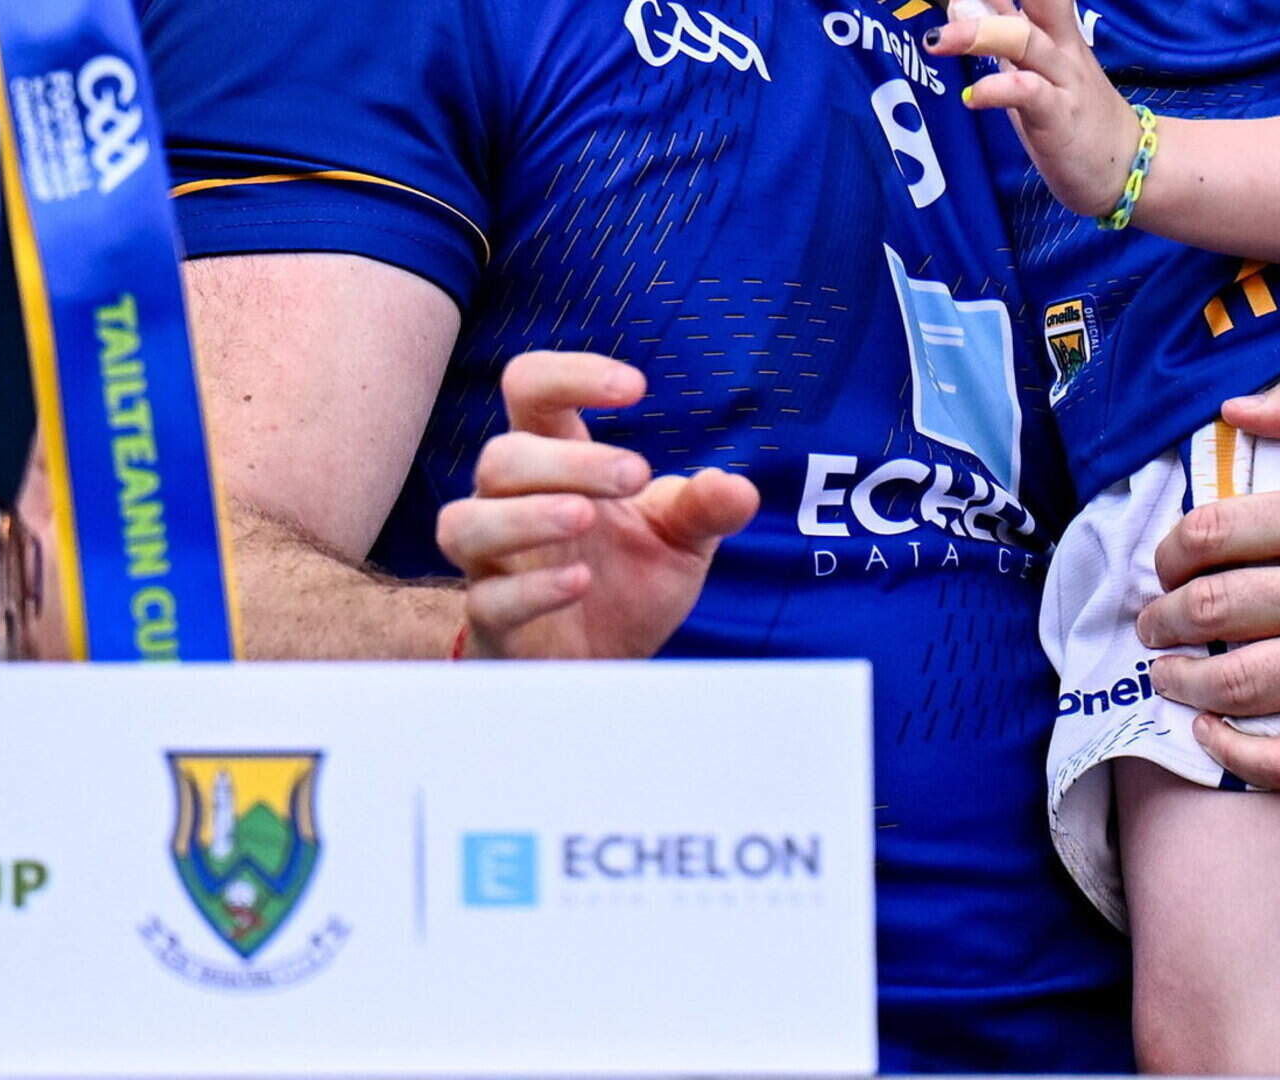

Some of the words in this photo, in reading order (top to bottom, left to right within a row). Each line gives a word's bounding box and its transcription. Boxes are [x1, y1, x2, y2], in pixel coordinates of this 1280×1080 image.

[871, 78, 946, 209] 9
[1084, 307, 1099, 350] OFFICIAL
[95, 293, 172, 581] TAILTEANN
[814, 542, 959, 576] DATA
[131, 585, 182, 663] CU
[1056, 658, 1156, 718] o'nei
[563, 833, 822, 879] ECHELON
